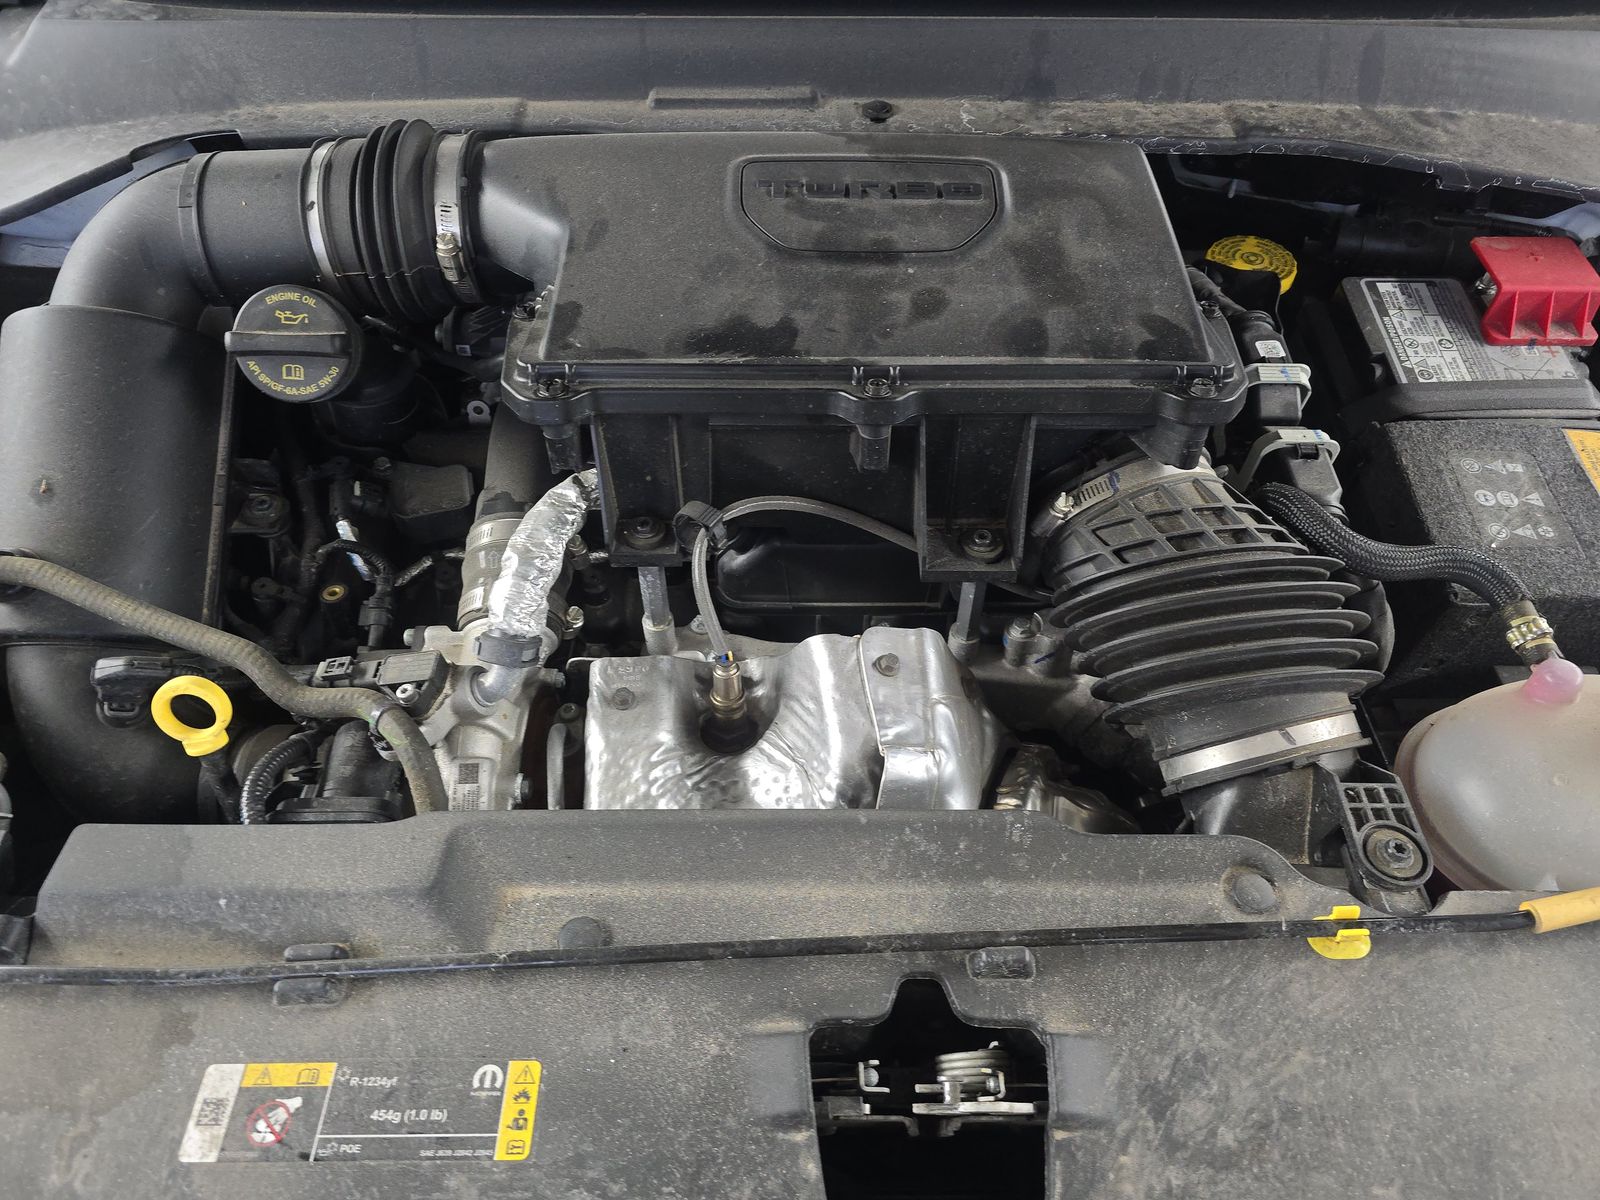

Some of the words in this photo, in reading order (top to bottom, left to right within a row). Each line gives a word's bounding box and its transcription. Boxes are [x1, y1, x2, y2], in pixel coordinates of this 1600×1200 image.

[755, 180, 983, 200] TURBO
[265, 291, 302, 305] ENGINE
[302, 295, 318, 308] OIL
[247, 360, 262, 375] API
[319, 366, 340, 388] 5W-30
[349, 1076, 399, 1088] R-1234yf
[370, 1110, 402, 1124] 454g
[403, 1109, 428, 1124] (1.0
[430, 1108, 448, 1123] lb)
[340, 1144, 362, 1154] POE
